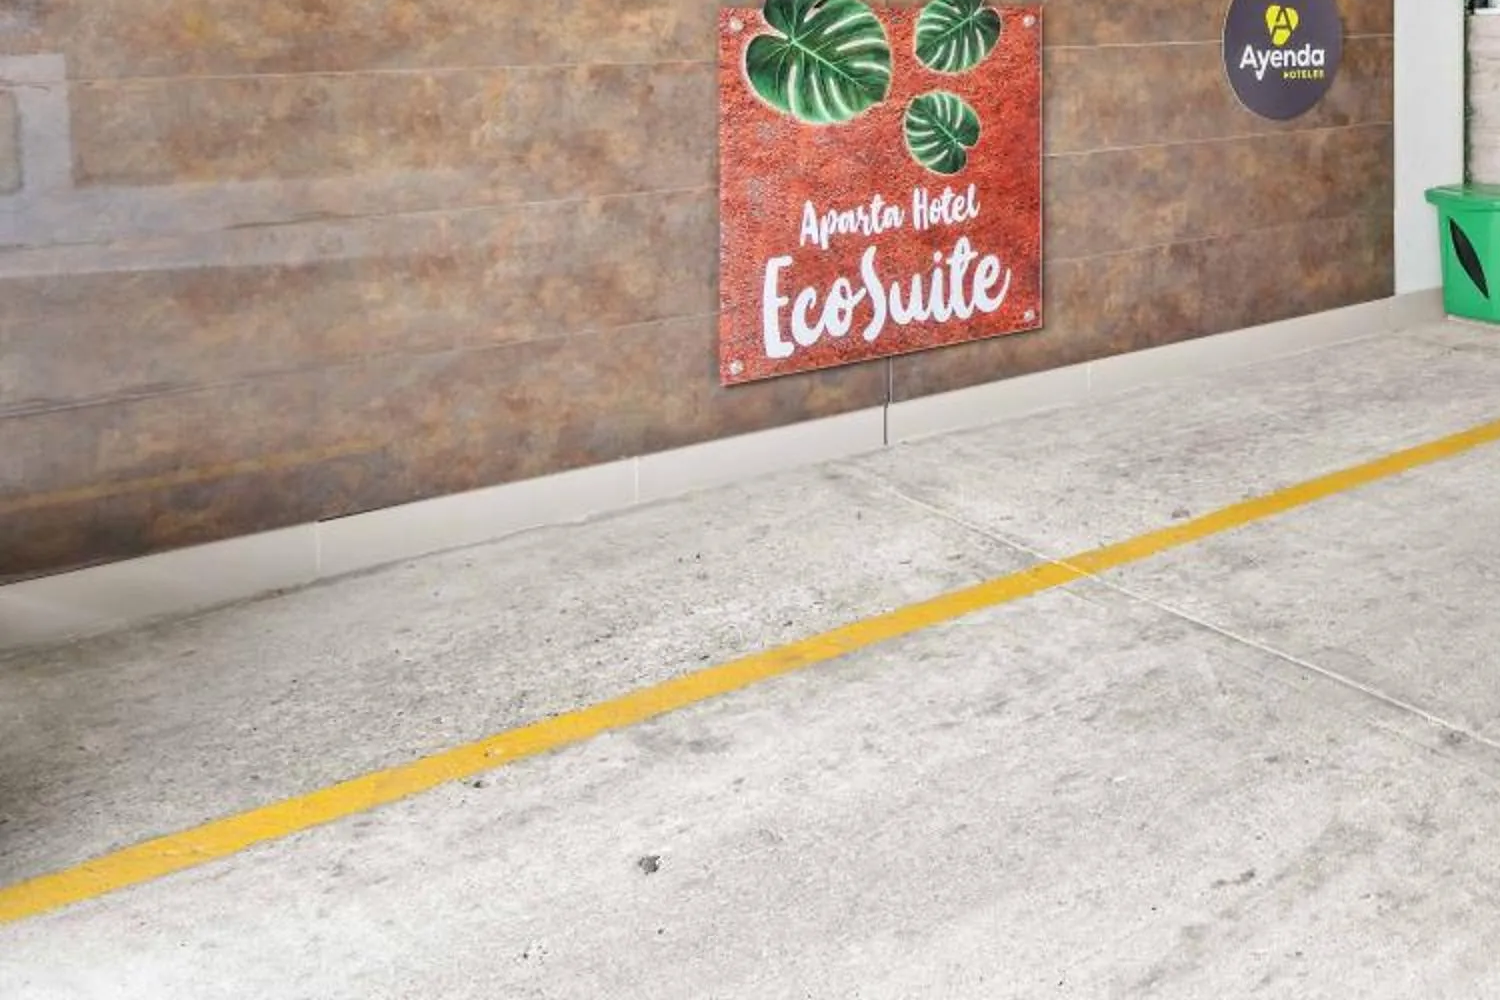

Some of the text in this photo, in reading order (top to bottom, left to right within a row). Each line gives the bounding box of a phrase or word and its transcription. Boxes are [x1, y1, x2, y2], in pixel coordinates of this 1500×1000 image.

[1240, 43, 1325, 81] Ayenda
[800, 183, 981, 250] Aparta Hotel
[763, 236, 1012, 359] EcoSuite
